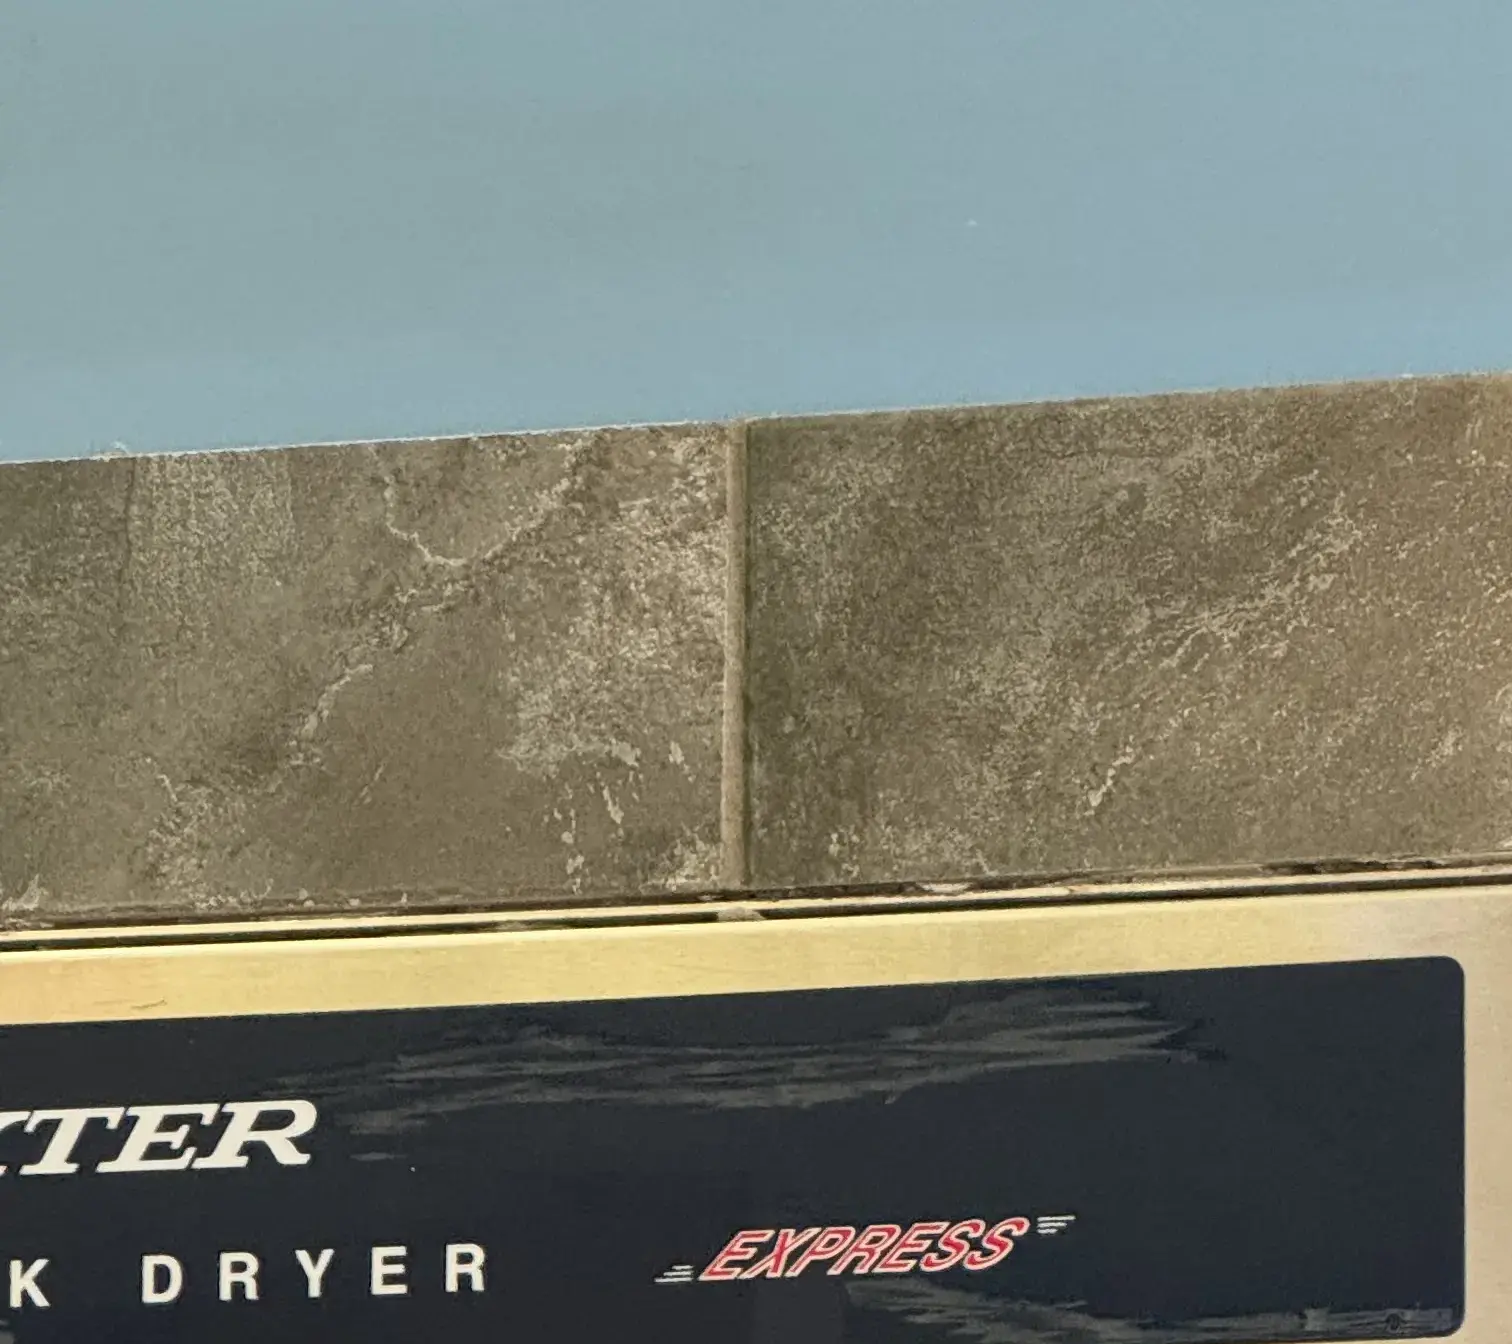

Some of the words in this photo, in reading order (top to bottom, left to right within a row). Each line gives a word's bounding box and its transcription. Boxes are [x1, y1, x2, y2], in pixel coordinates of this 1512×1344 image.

[9, 1258, 51, 1308] K
[142, 1243, 487, 1304] DRYER
[698, 1216, 1031, 1281] EXPRESS
